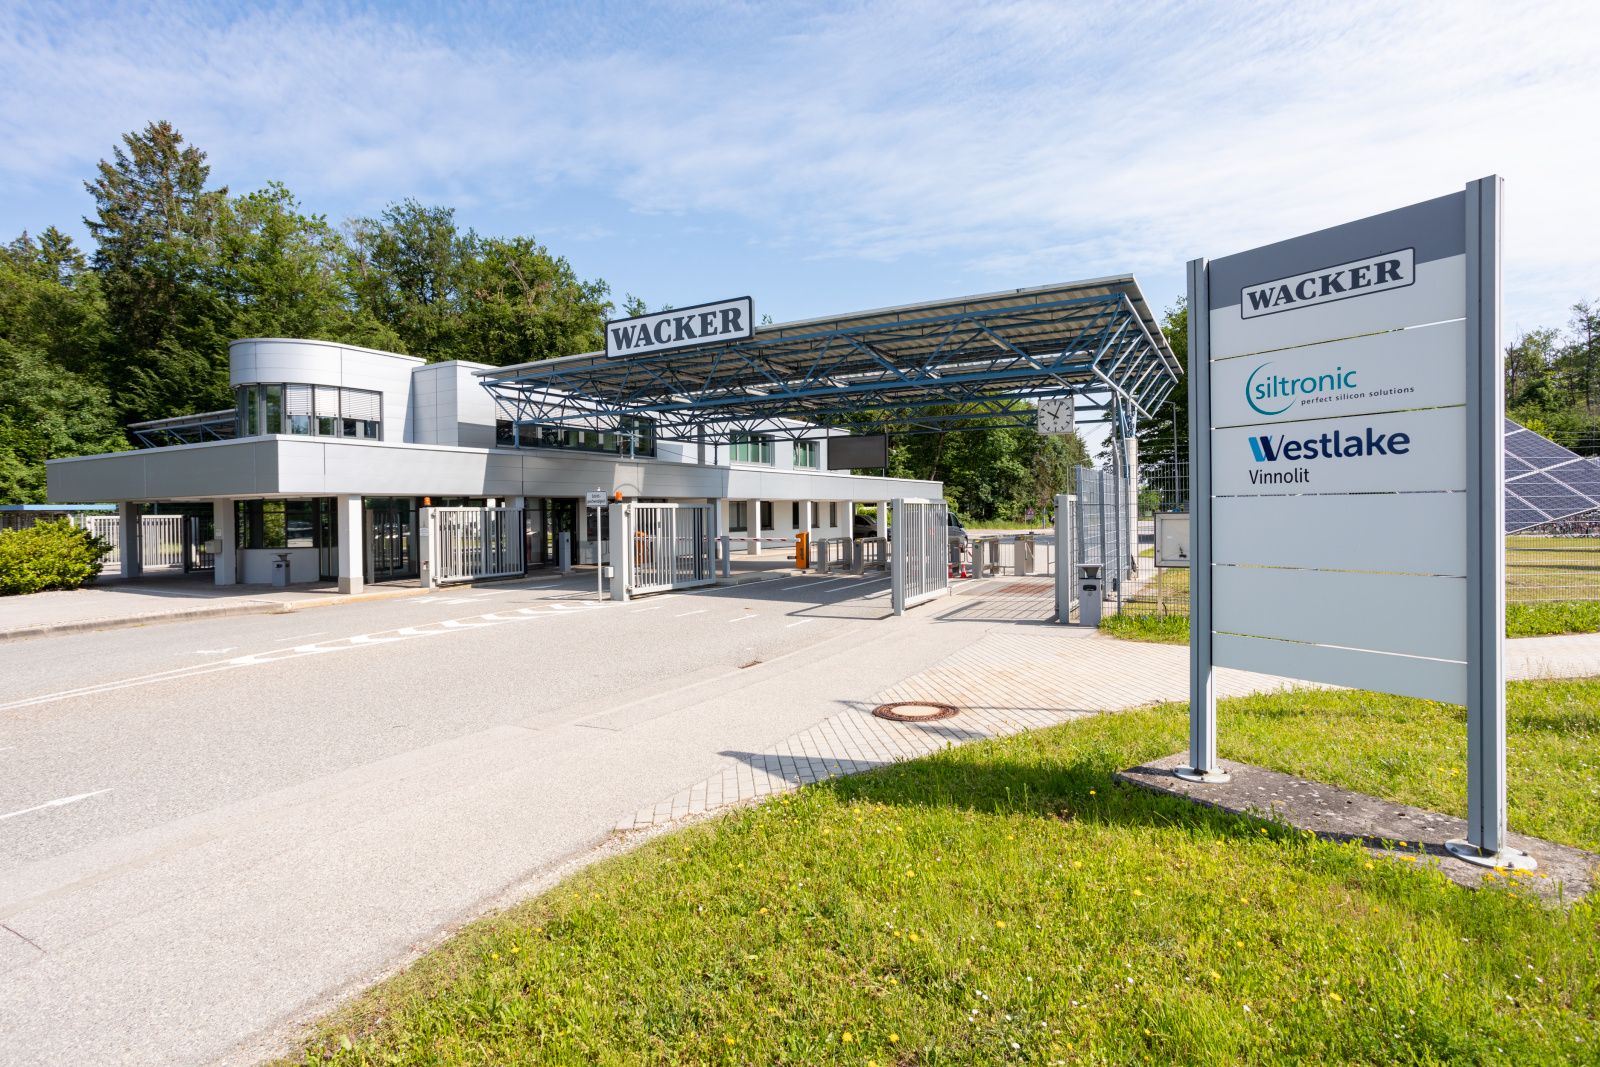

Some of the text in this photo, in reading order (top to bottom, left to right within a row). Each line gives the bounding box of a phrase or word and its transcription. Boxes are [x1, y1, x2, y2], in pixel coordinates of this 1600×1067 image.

[1247, 259, 1404, 310] WACKER
[611, 307, 744, 350] WACKER
[1255, 366, 1357, 399] siltronic
[1300, 386, 1415, 406] perfect silicon solutions
[1248, 427, 1411, 462] Westlake
[1249, 467, 1310, 485] Vinnolit
